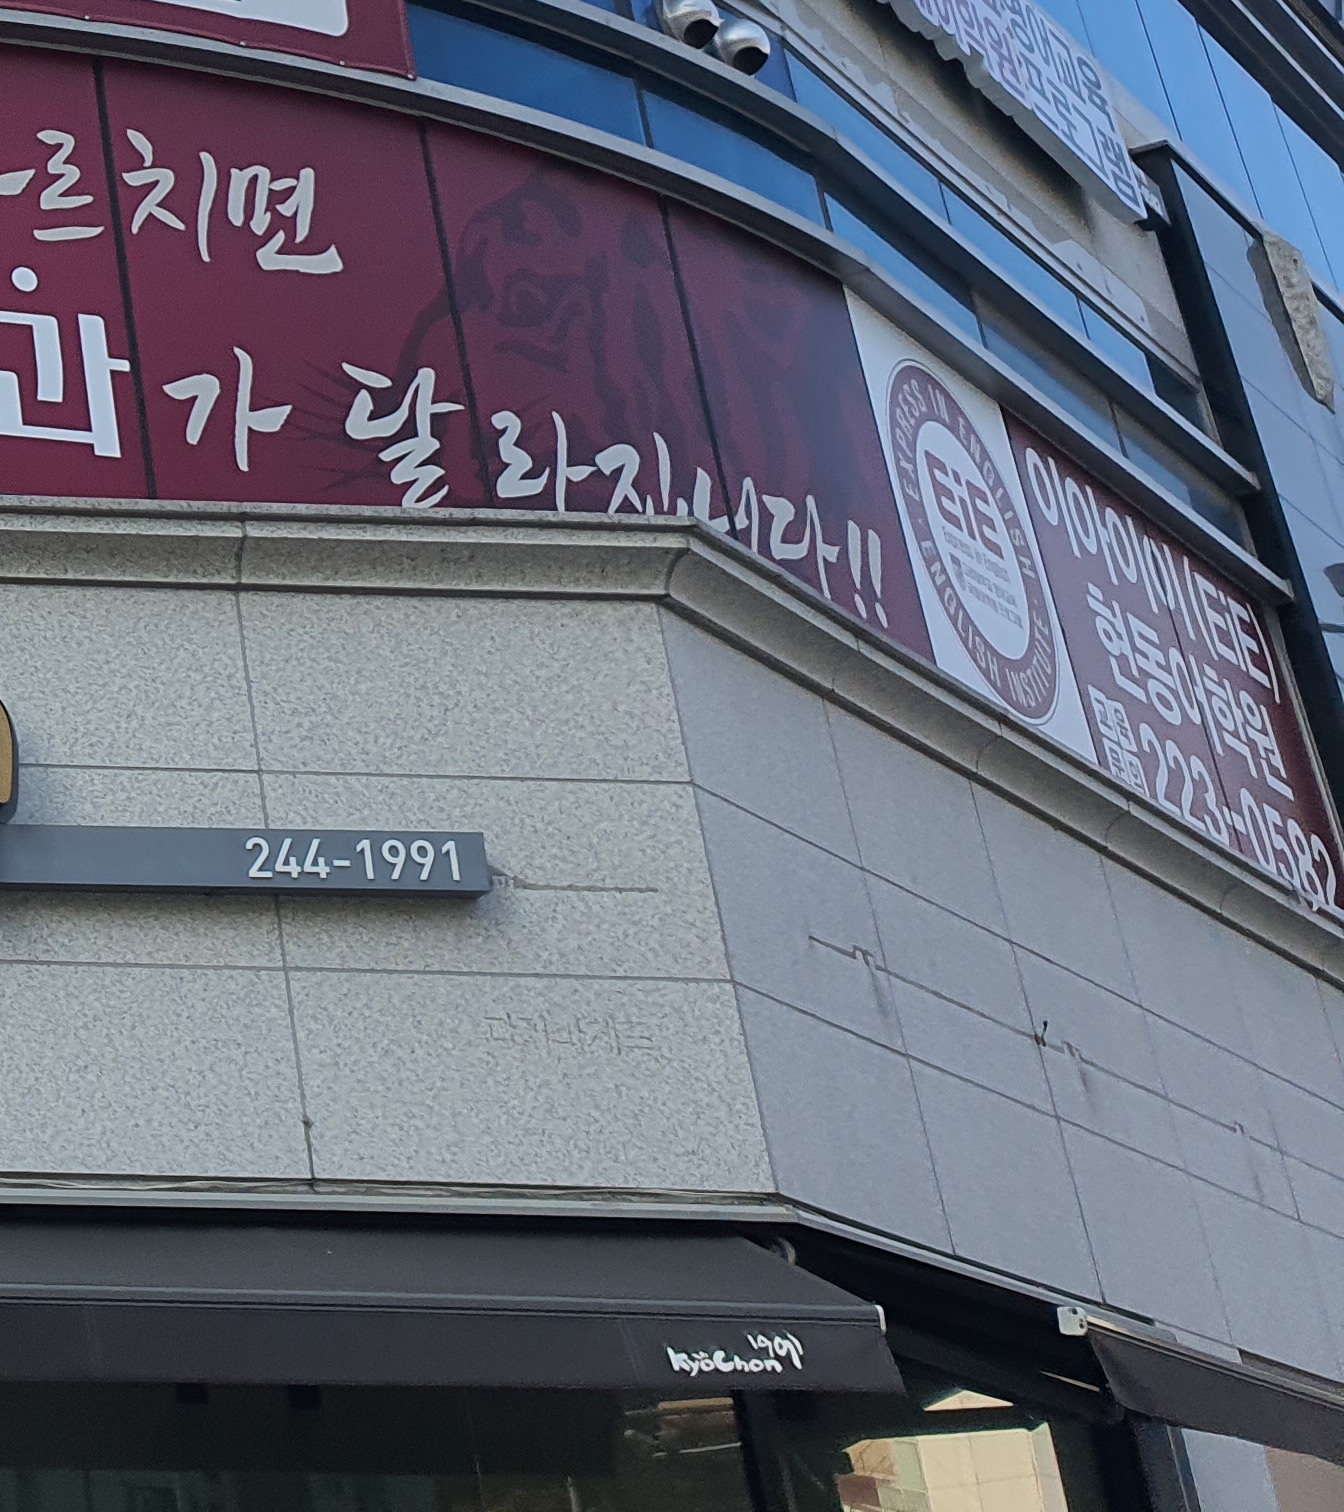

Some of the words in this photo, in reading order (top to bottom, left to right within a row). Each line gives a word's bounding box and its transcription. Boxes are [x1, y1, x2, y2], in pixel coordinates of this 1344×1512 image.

[896, 378, 928, 502] EXPRESS
[958, 416, 1037, 579] ENGLISH
[920, 539, 1002, 687] ENGLISH
[1087, 580, 1295, 802] 현동어학원
[244, 836, 463, 884] 244-1991
